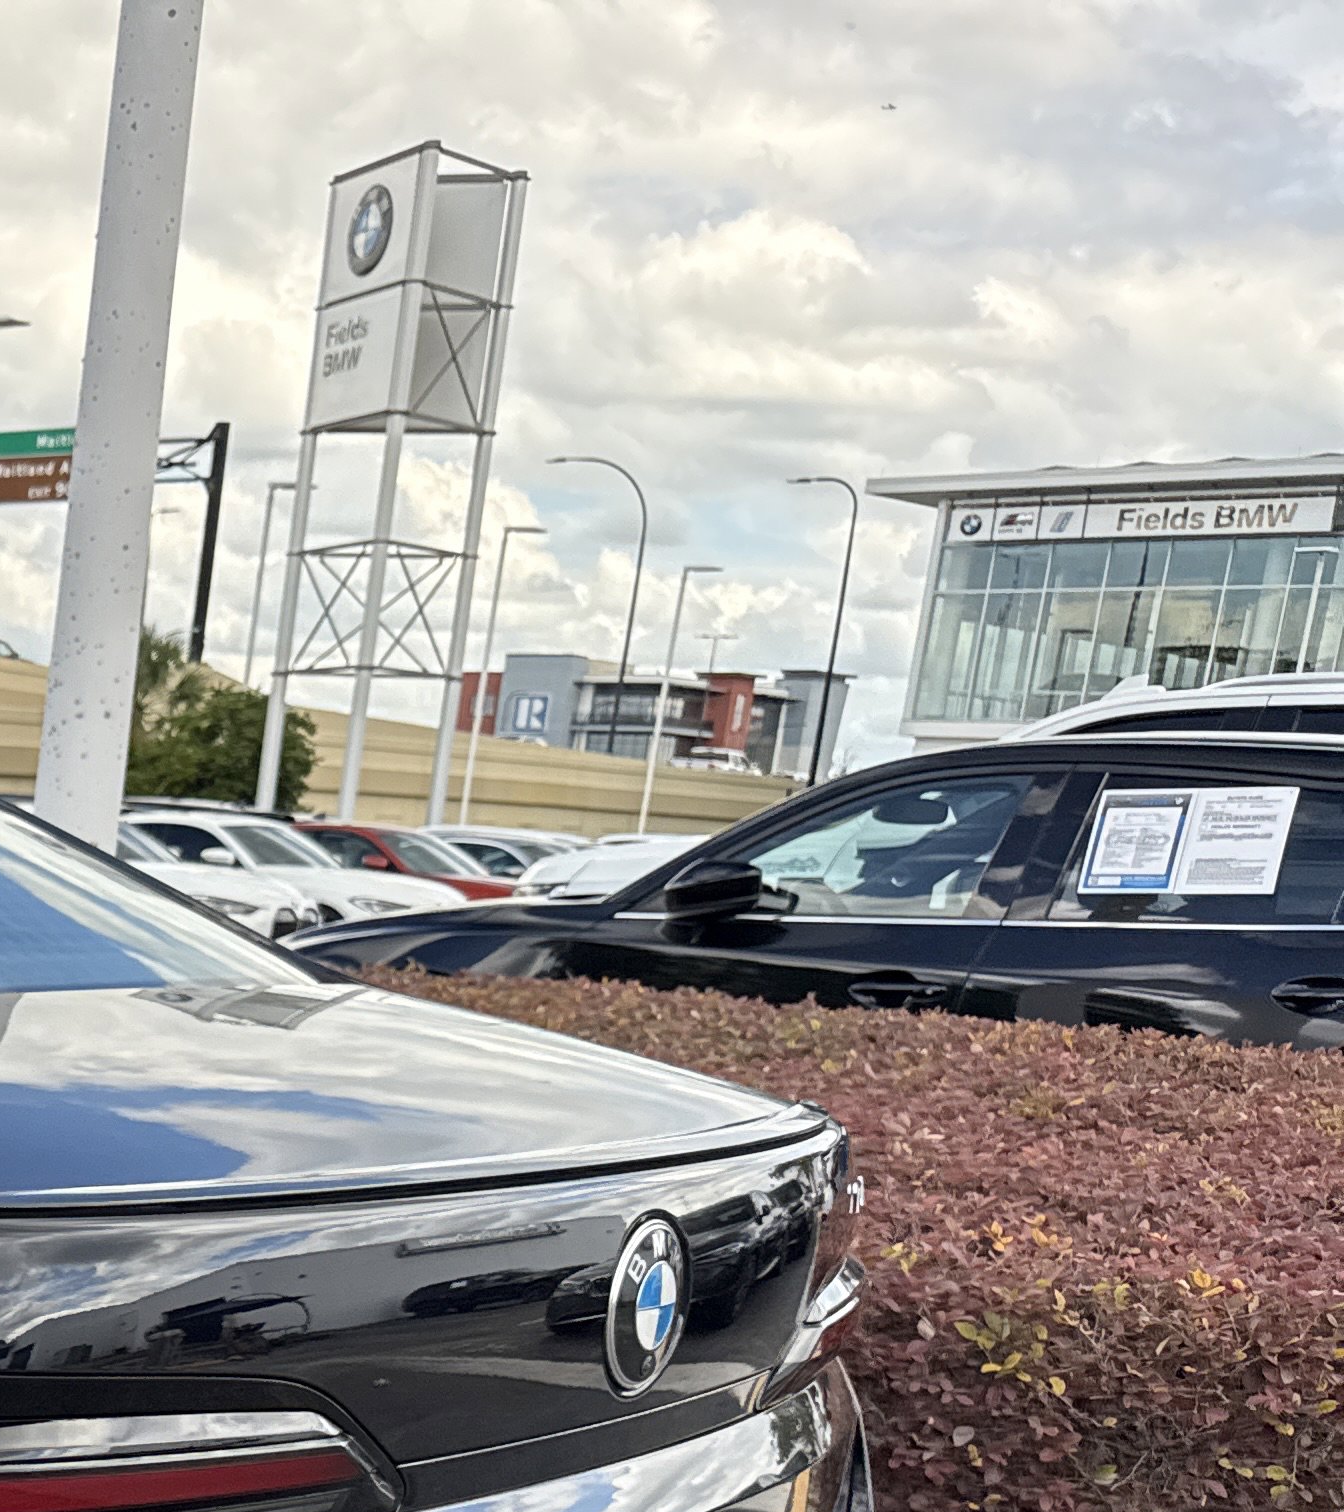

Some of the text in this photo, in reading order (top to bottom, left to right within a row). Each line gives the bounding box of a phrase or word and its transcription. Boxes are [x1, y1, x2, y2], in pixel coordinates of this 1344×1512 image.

[325, 315, 369, 348] Fields
[322, 345, 363, 377] BMW
[1116, 502, 1299, 533] Fields BMW
